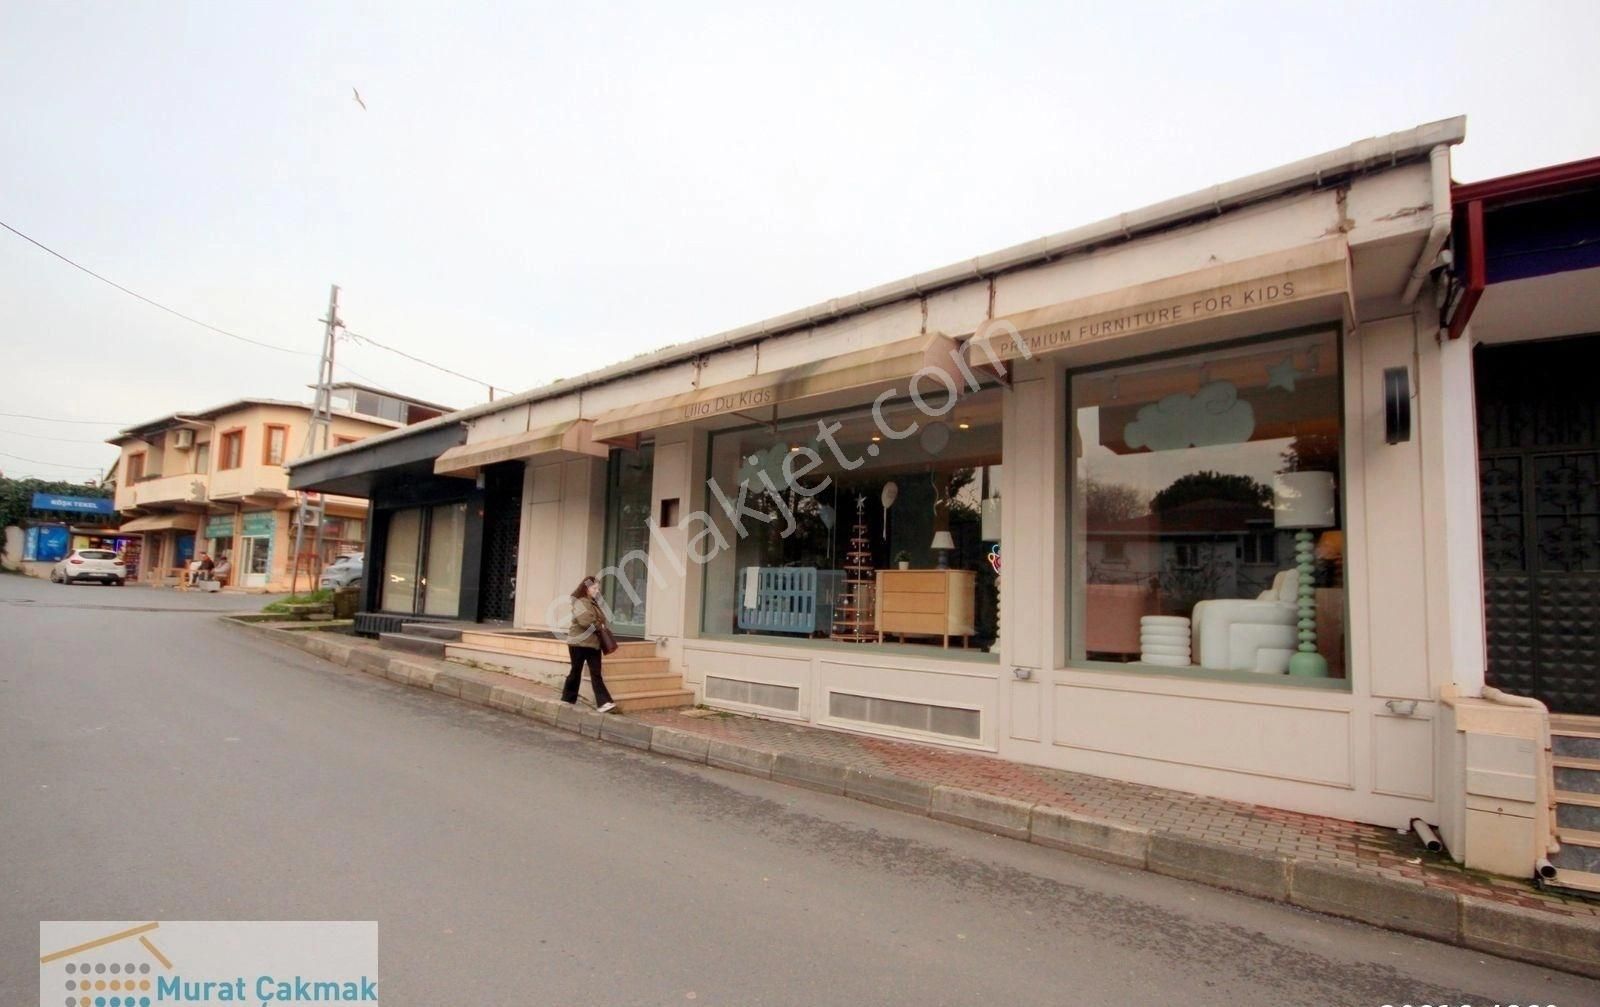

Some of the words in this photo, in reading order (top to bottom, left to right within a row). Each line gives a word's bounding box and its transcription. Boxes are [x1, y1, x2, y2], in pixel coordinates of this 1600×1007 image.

[1000, 329, 1072, 354] PREMIUM
[1080, 305, 1182, 338] FURNITURE
[1193, 295, 1233, 314] FOR
[1243, 281, 1296, 304] KIDS
[715, 396, 734, 411] Du
[739, 388, 771, 406] Kids
[74, 501, 98, 509] TEKEL
